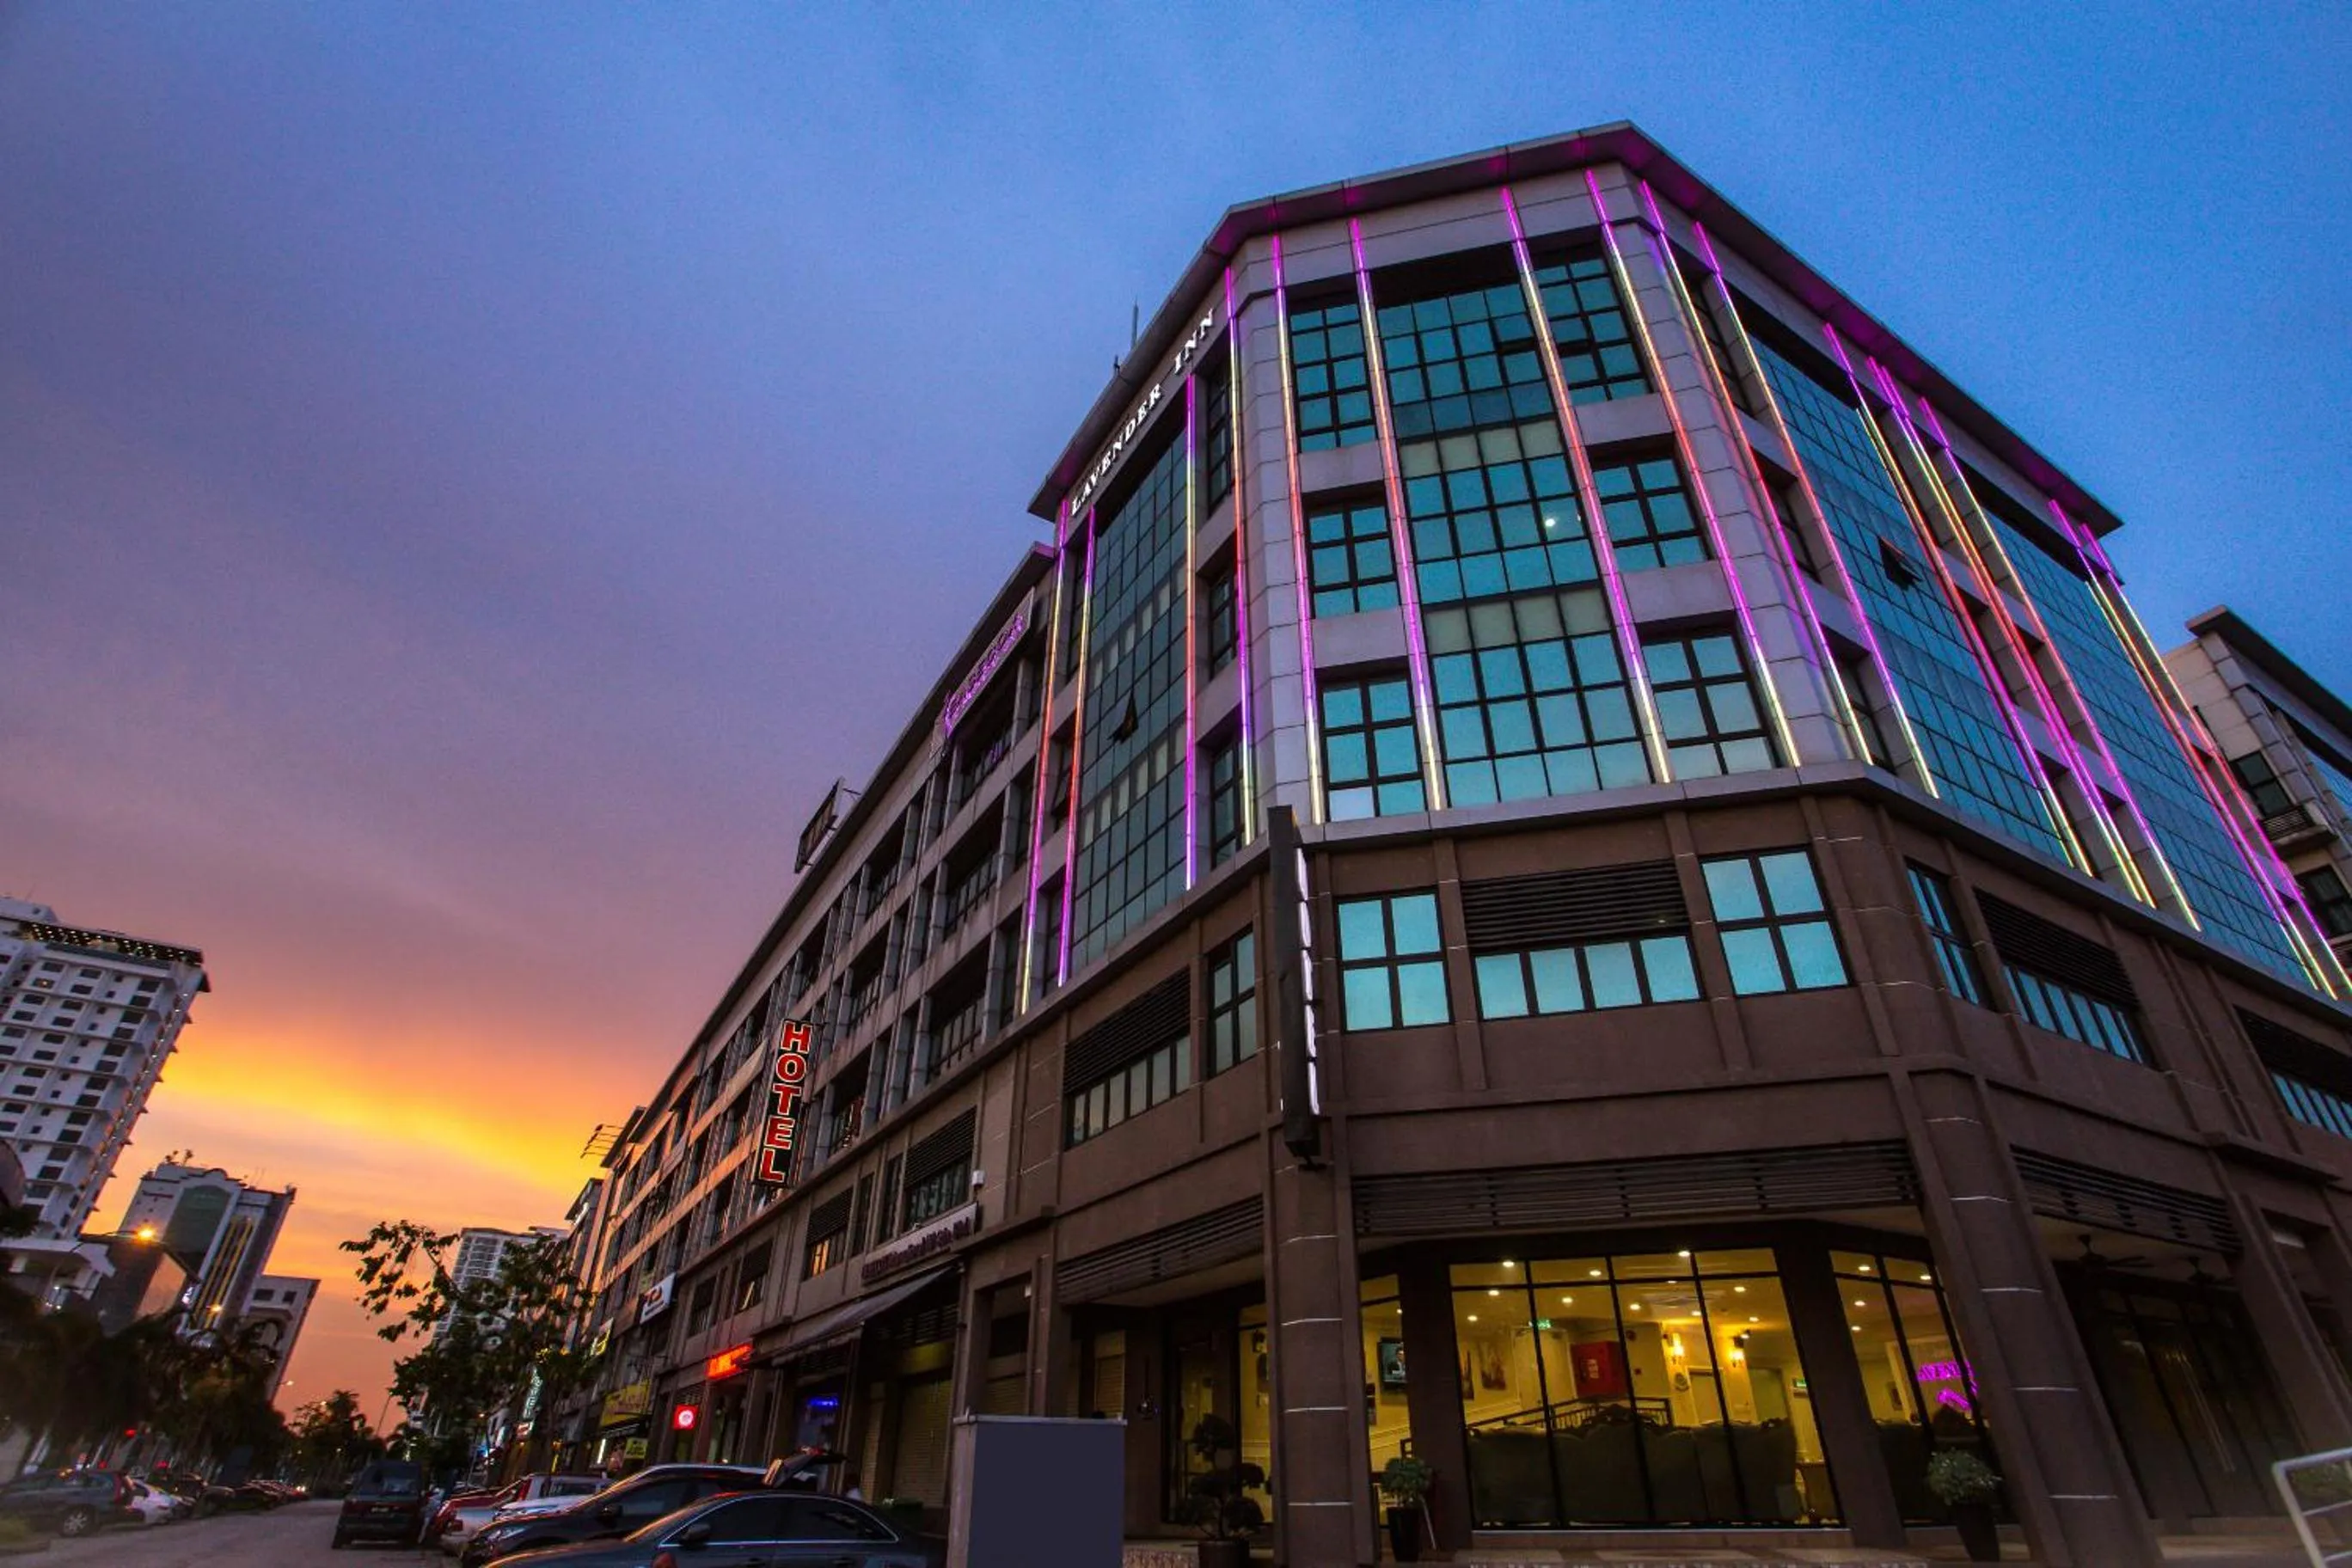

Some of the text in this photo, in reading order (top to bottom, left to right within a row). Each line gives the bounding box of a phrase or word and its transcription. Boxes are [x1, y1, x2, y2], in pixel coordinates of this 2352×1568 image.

[1071, 308, 1214, 517] LAVENDER INN
[758, 1020, 813, 1183] HOTEL
